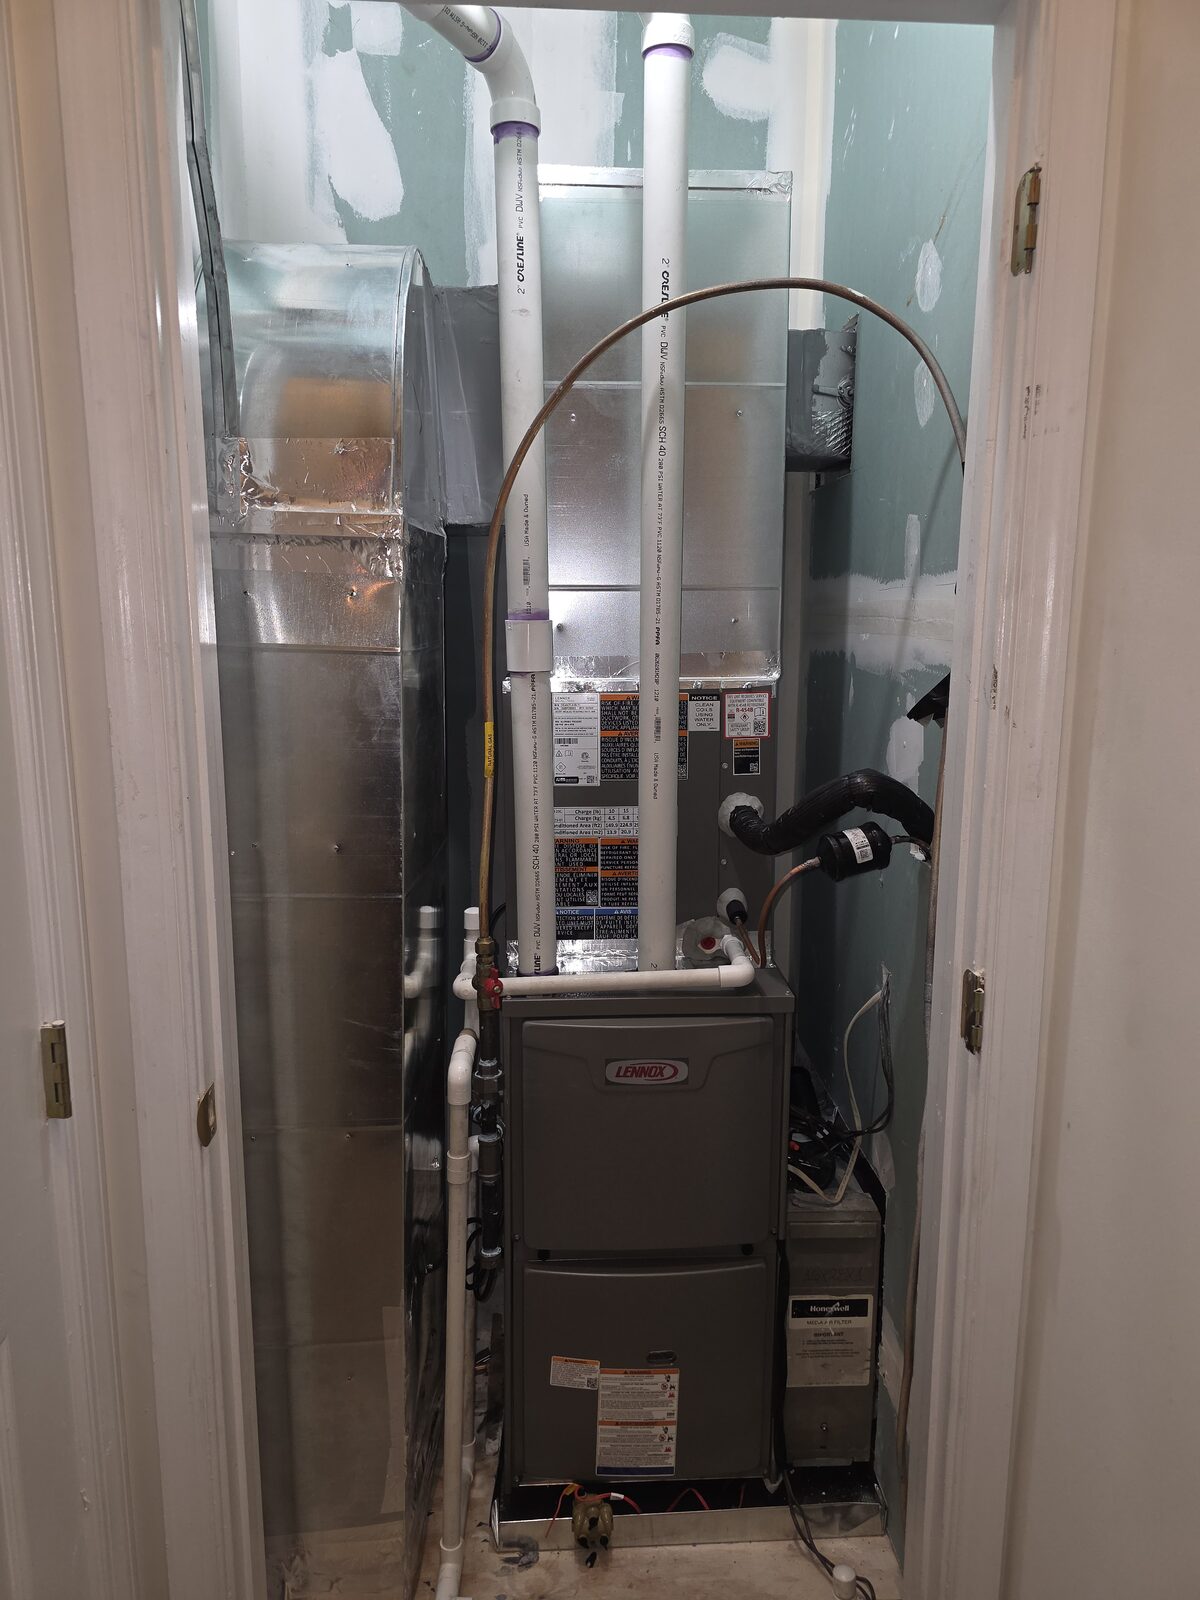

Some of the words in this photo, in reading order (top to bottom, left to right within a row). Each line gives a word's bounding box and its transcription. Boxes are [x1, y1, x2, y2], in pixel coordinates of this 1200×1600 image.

[515, 194, 523, 212] DWV
[660, 342, 669, 360] DWV
[658, 426, 667, 442] SCH
[658, 445, 667, 457] 40
[532, 844, 539, 854] 40
[615, 1065, 667, 1078] LENNOX
